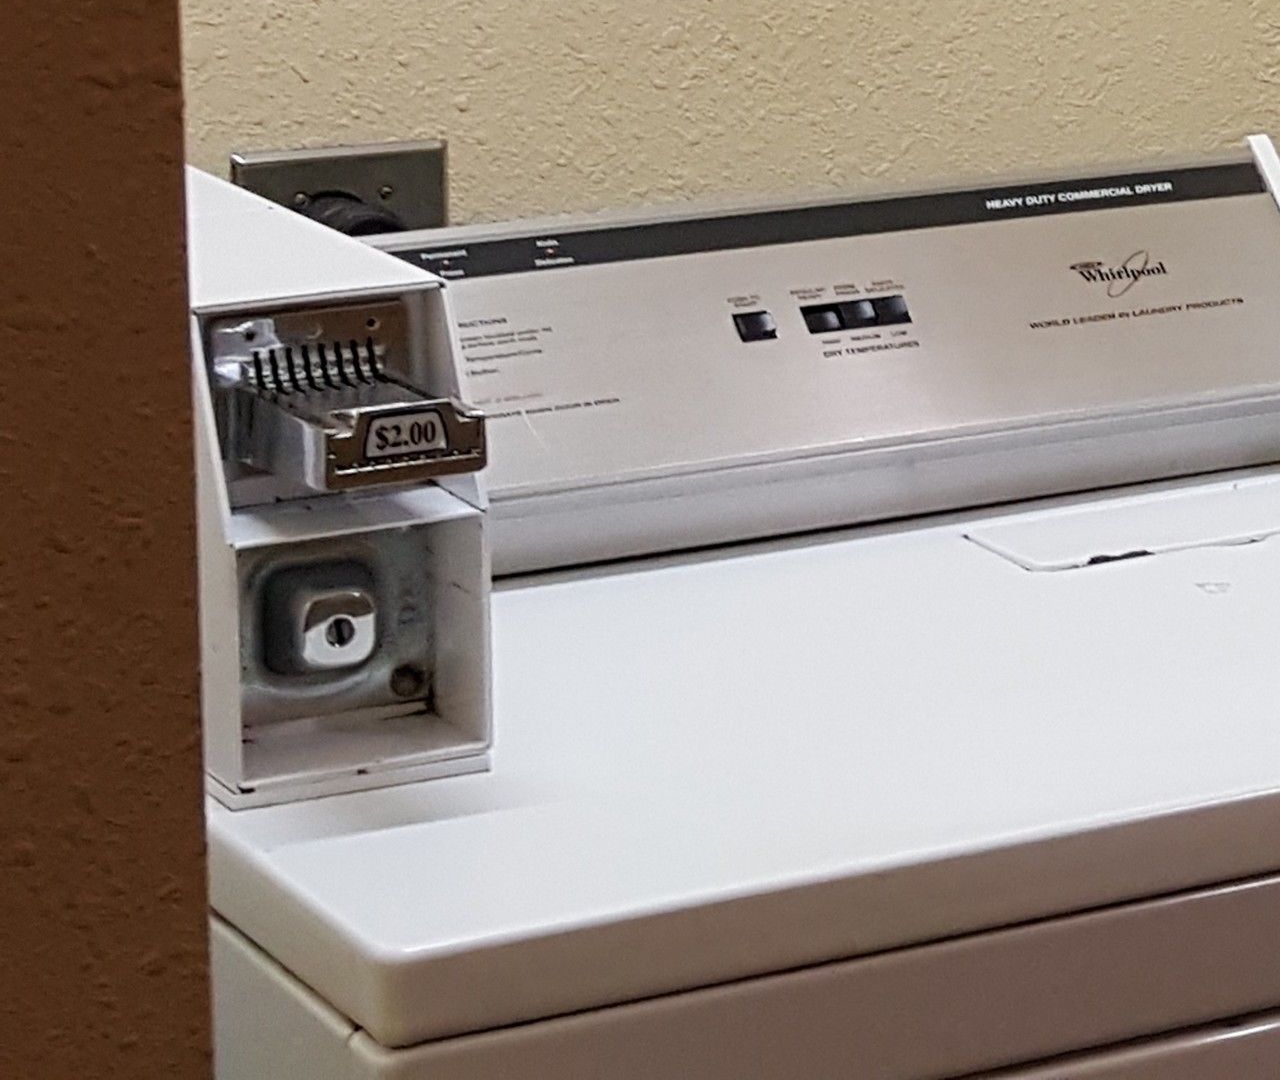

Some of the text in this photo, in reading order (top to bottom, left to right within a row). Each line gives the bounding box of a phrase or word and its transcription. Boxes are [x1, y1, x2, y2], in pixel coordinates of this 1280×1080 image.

[985, 182, 1173, 210] HEAVY DUTY COMMERCIAL DRYER
[1070, 258, 1168, 287] Whirlpool
[375, 420, 436, 451] $2.00
